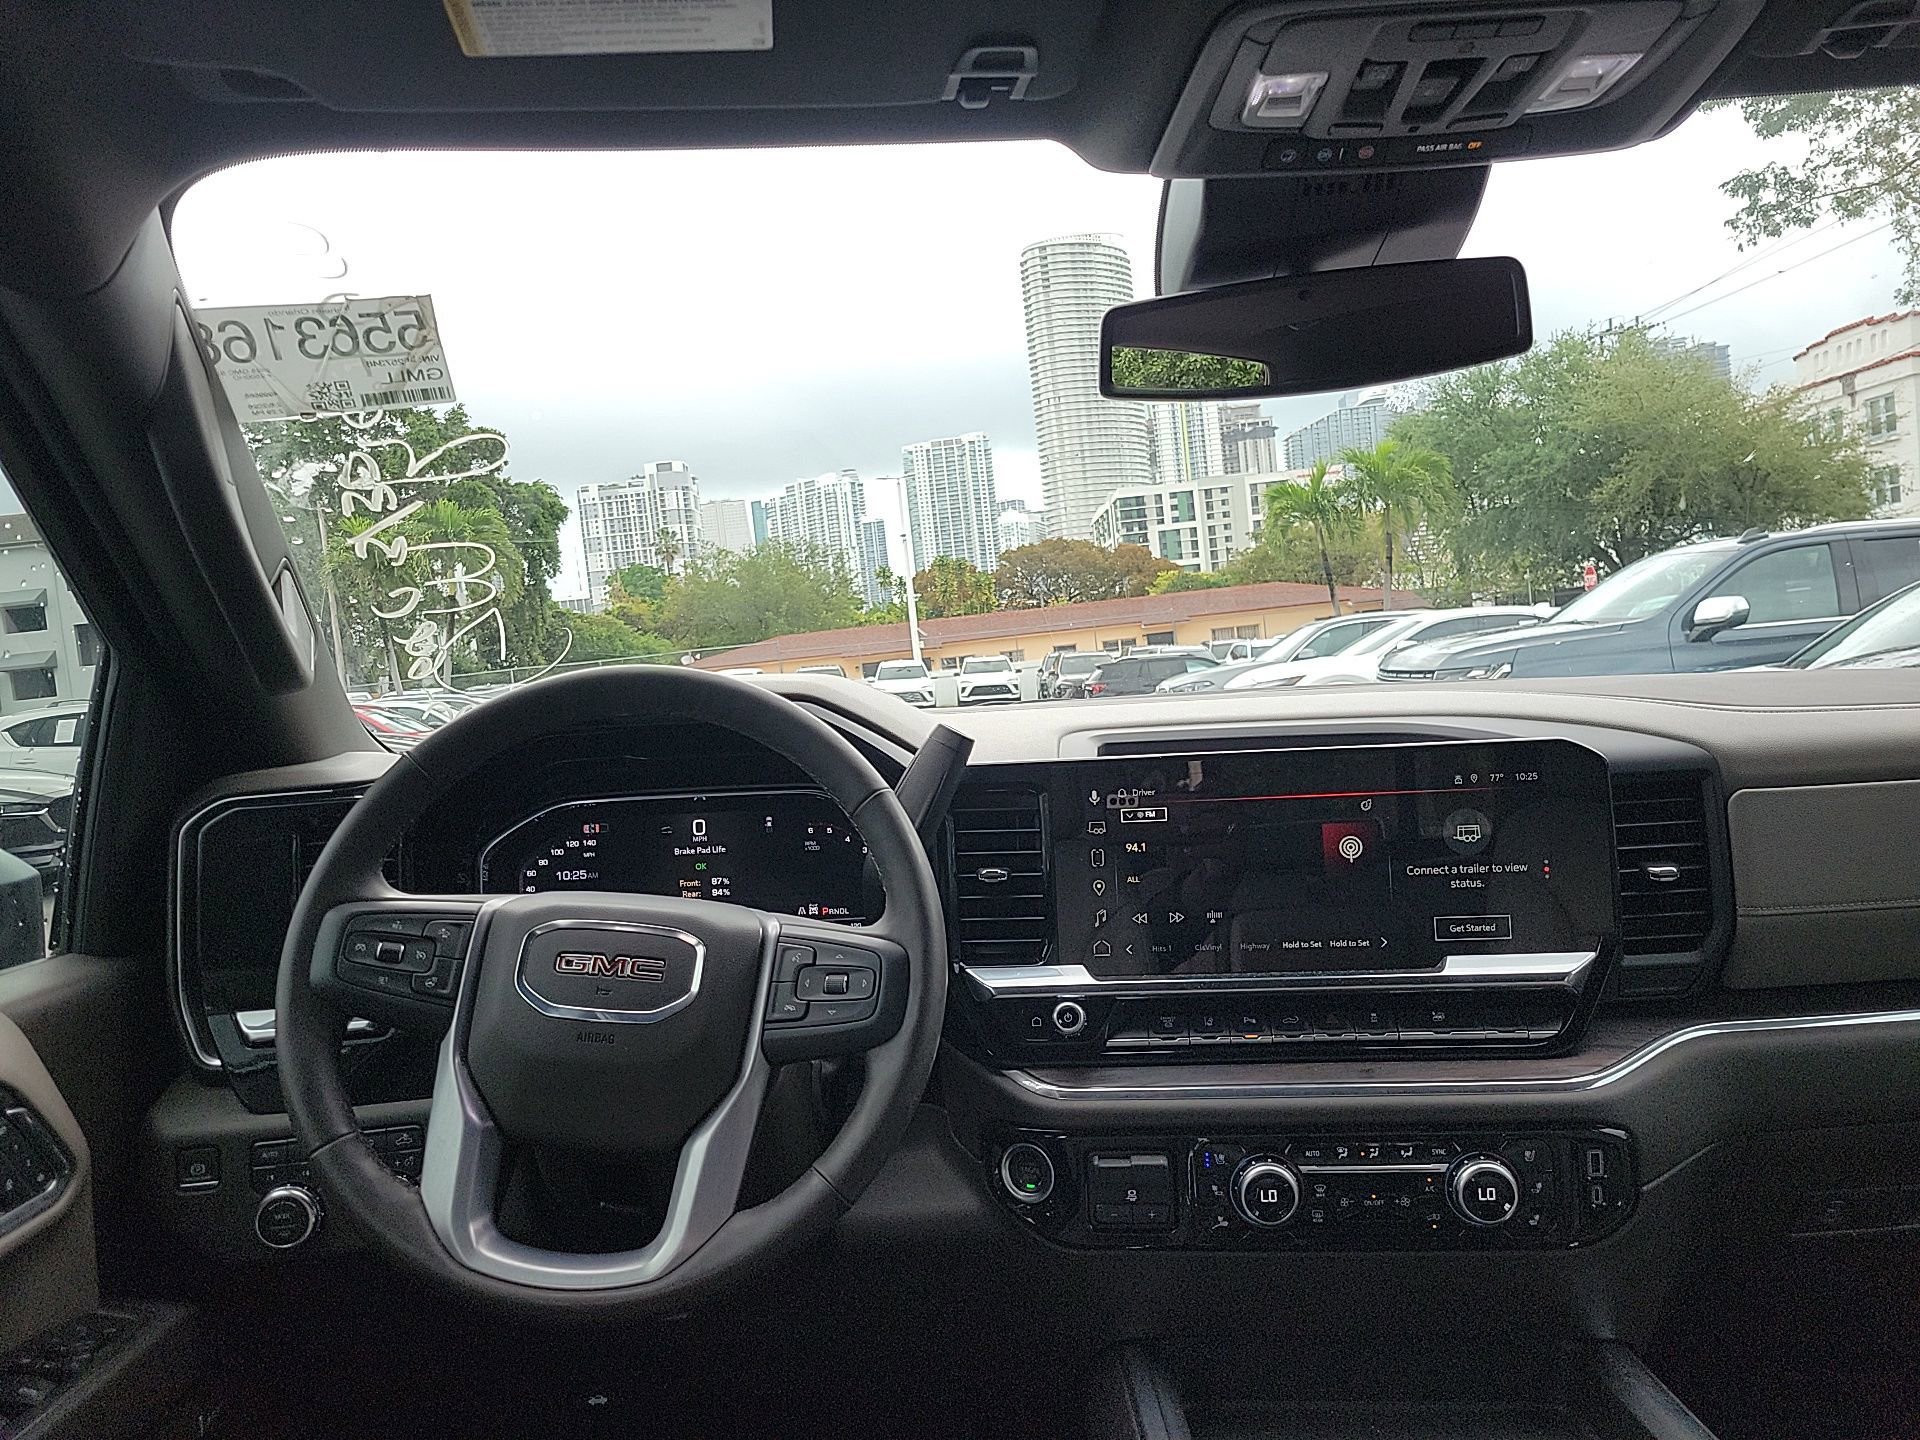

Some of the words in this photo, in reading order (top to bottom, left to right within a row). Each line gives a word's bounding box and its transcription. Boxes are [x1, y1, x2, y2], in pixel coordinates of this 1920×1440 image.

[1416, 144, 1435, 152] PASS
[1435, 143, 1449, 151] AIR
[1467, 141, 1482, 149] OFF
[1515, 772, 1538, 781] 10:25
[1132, 787, 1155, 797] Driver
[566, 840, 579, 848] 120
[583, 839, 597, 847] 140
[1125, 842, 1147, 852] 94.1
[550, 848, 564, 856] 100
[674, 846, 696, 856] Brake
[696, 845, 711, 854] Pad
[712, 845, 727, 853] Life
[862, 846, 868, 854] 3
[695, 862, 707, 871] OK
[1406, 864, 1449, 876] Connect
[1451, 866, 1458, 874] a
[1459, 863, 1489, 874] trailer
[1491, 863, 1503, 873] to
[1504, 862, 1529, 873] view
[555, 869, 587, 881] 10:25
[1126, 875, 1141, 884] ALL
[679, 880, 701, 888] Front:
[711, 877, 731, 886] 87%
[1450, 877, 1485, 889] status.
[525, 885, 536, 893] 40
[682, 890, 702, 899] Rear:
[711, 888, 731, 897] 94%
[1449, 923, 1465, 933] Get
[1465, 922, 1496, 933] Started
[1152, 944, 1167, 952] Hits
[1240, 942, 1271, 952] Highway
[1282, 940, 1300, 949] Hold
[1310, 940, 1322, 948] Set
[1329, 939, 1347, 948] Hold
[1357, 939, 1370, 947] Set
[556, 953, 666, 982] GMC
[577, 1031, 616, 1045] AIRBAG
